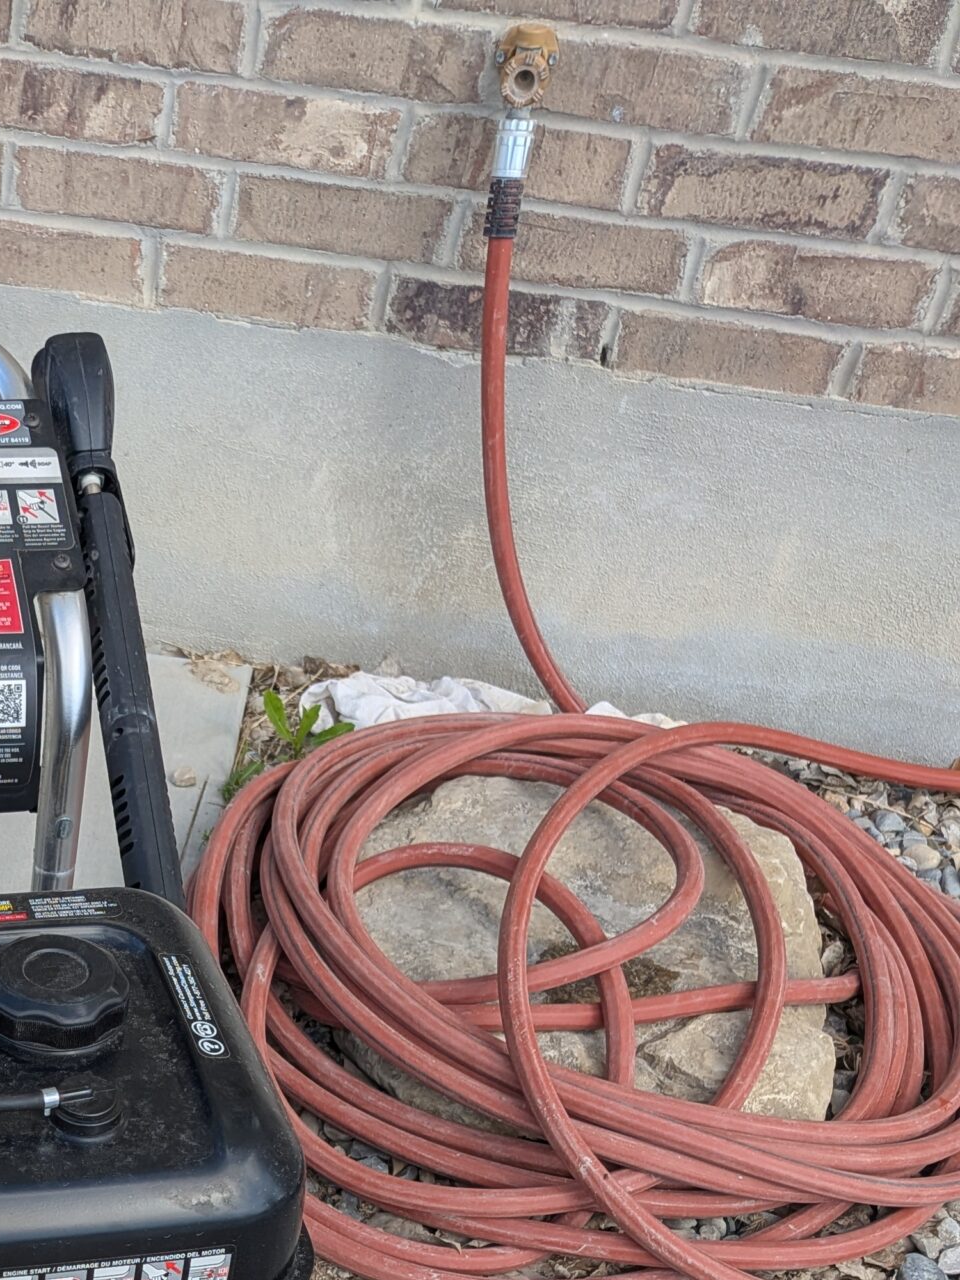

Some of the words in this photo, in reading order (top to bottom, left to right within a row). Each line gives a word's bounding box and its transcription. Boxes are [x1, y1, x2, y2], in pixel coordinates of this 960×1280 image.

[57, 1262, 99, 1271] DÉMARRAGE
[112, 1257, 140, 1266] MOTEUR
[146, 1252, 185, 1261] ENCENDIDO
